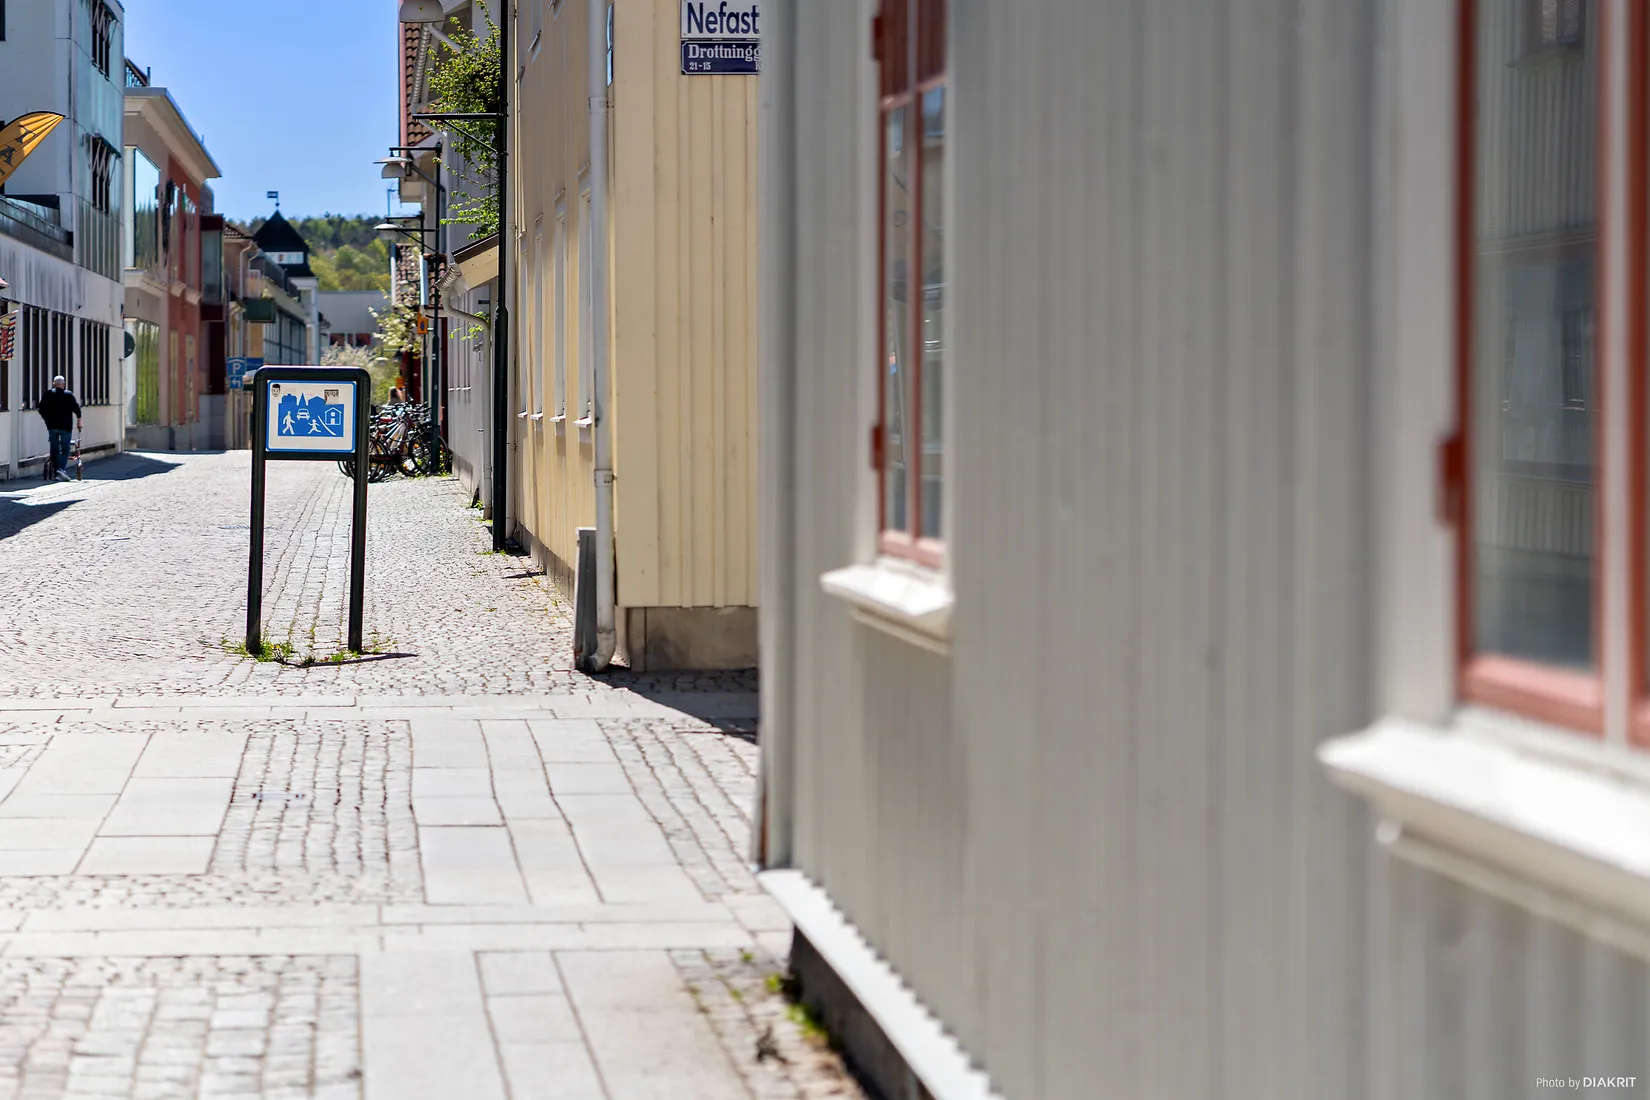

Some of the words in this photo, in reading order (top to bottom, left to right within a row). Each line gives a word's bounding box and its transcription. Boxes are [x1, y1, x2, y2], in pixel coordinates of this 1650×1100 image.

[687, 1, 760, 34] Nefast
[688, 44, 761, 62] Drottningg
[689, 61, 711, 70] 21-15
[232, 362, 241, 374] P
